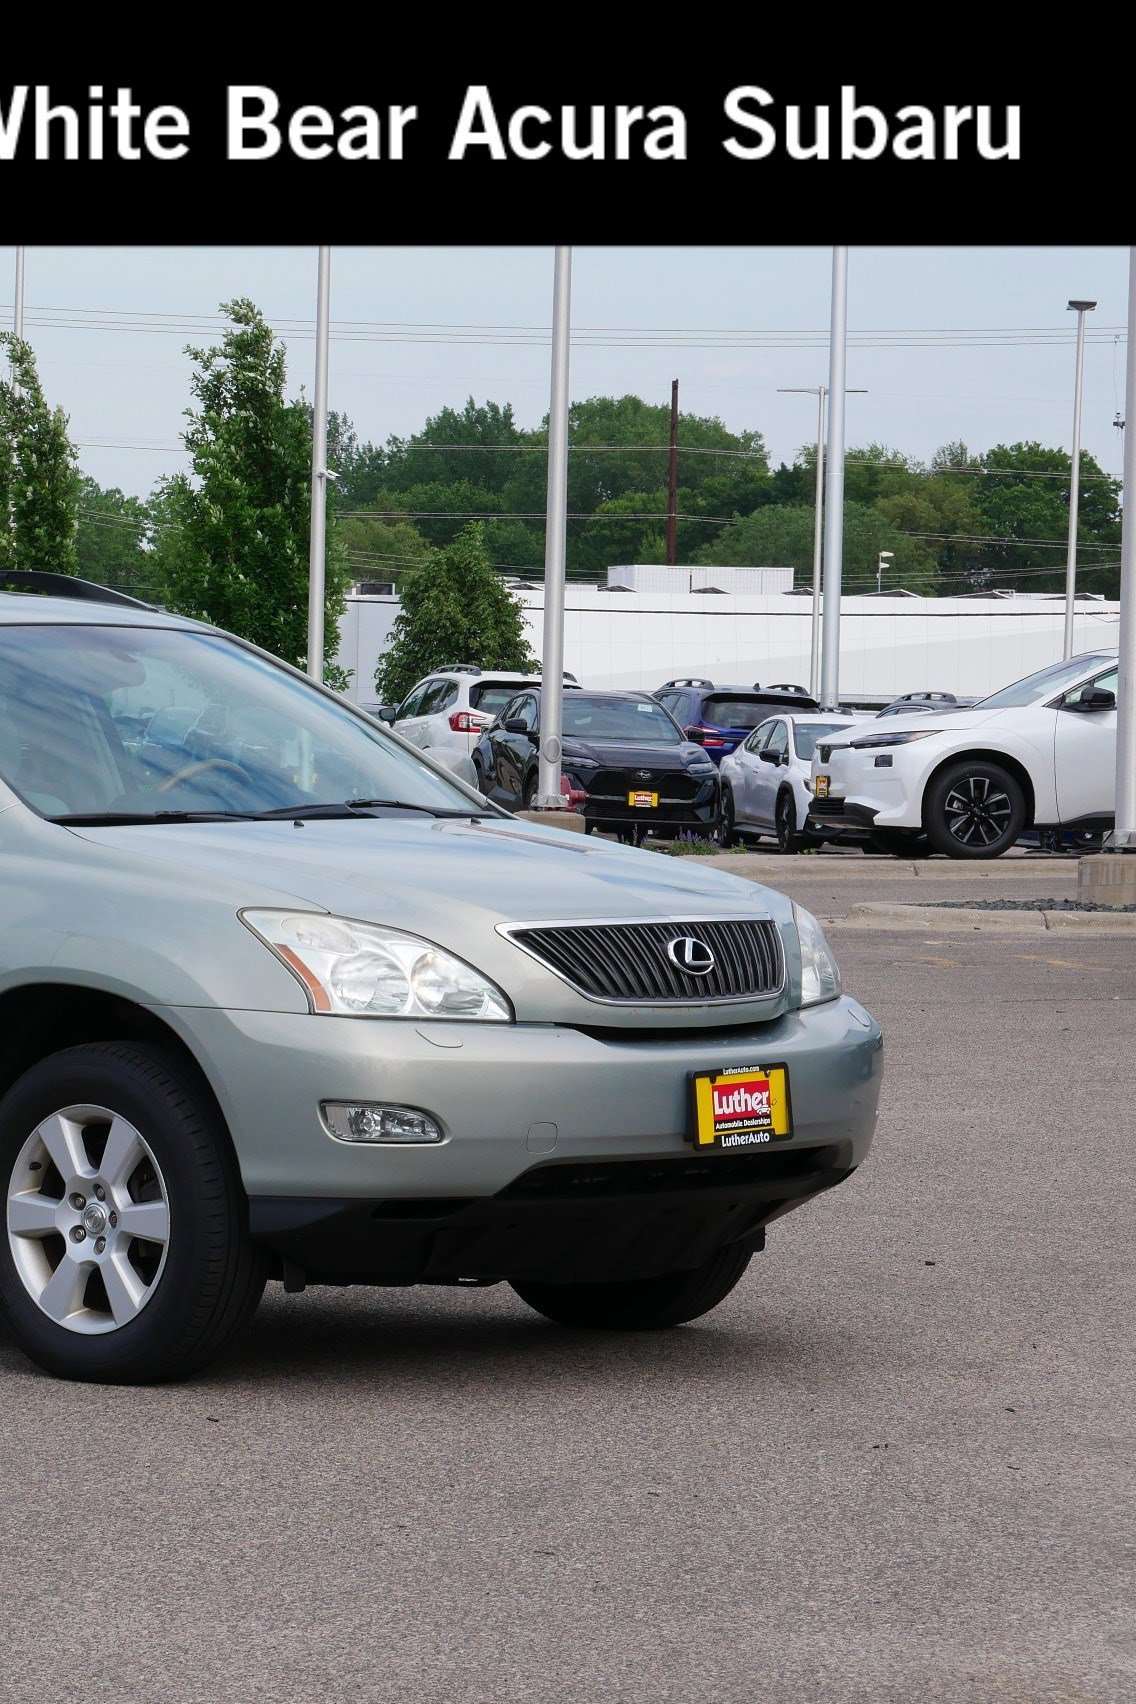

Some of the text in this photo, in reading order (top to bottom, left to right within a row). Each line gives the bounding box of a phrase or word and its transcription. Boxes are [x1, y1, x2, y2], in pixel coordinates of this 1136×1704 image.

[722, 1066, 760, 1075] LutherAuto.com
[713, 1088, 770, 1115] Luther
[715, 1117, 771, 1130] Automobile Dealerships
[721, 1132, 770, 1148] LutherAuto
